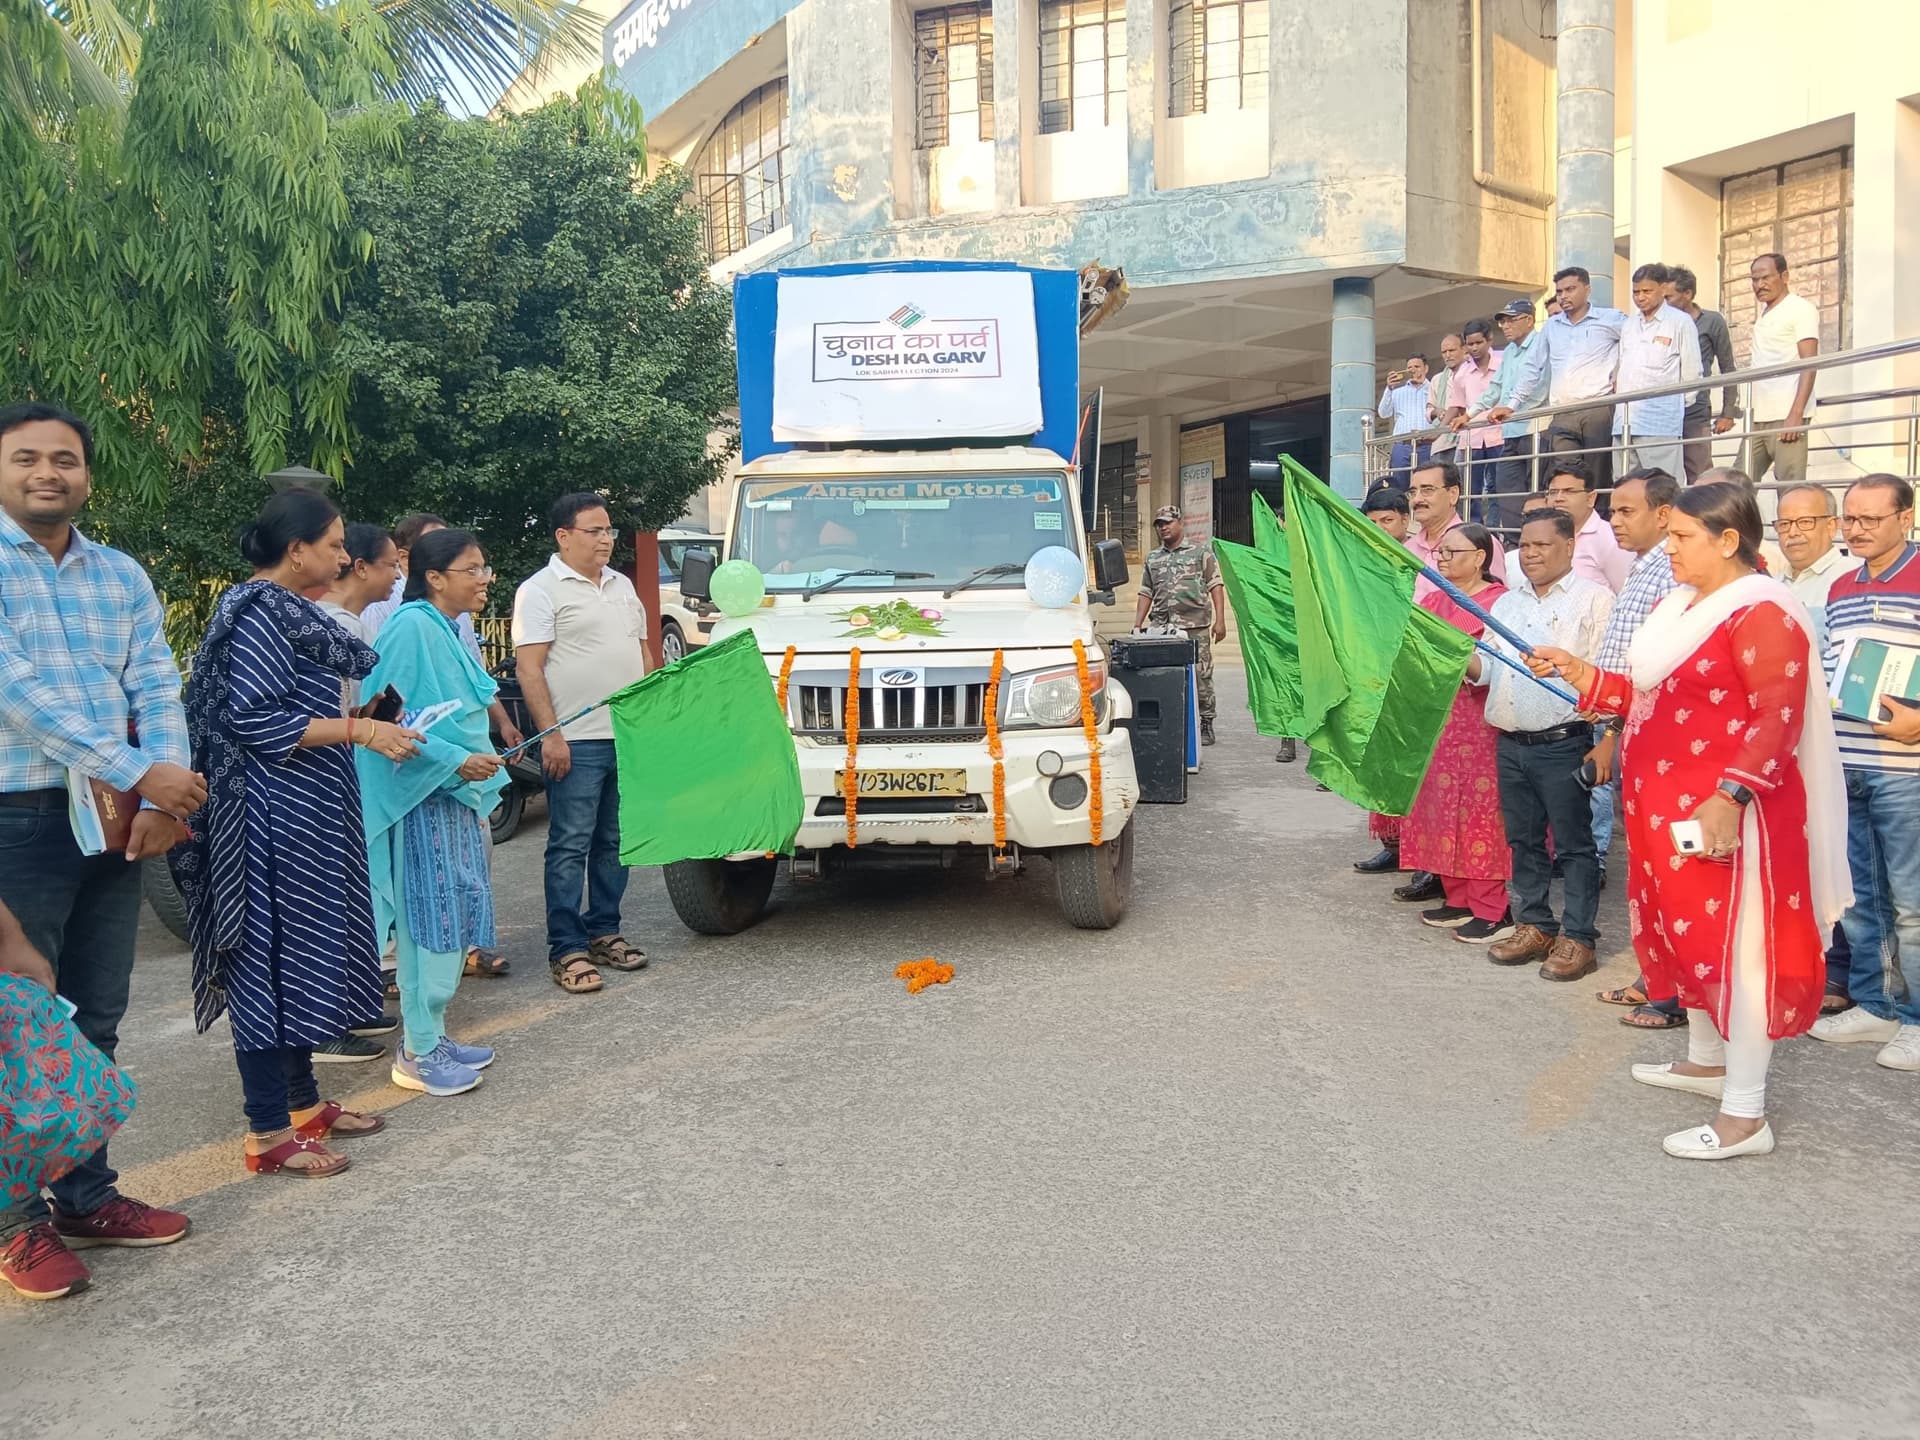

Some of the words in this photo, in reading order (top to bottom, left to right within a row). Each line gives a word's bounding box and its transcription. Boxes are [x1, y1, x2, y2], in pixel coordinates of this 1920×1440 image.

[822, 334, 896, 359] चुनाव
[903, 333, 943, 350] का
[947, 326, 990, 349] पर्व
[851, 353, 900, 367] DESH
[903, 352, 931, 366] KA
[933, 351, 987, 365] GARV
[806, 483, 906, 498] Anand
[917, 482, 1025, 498] Motors
